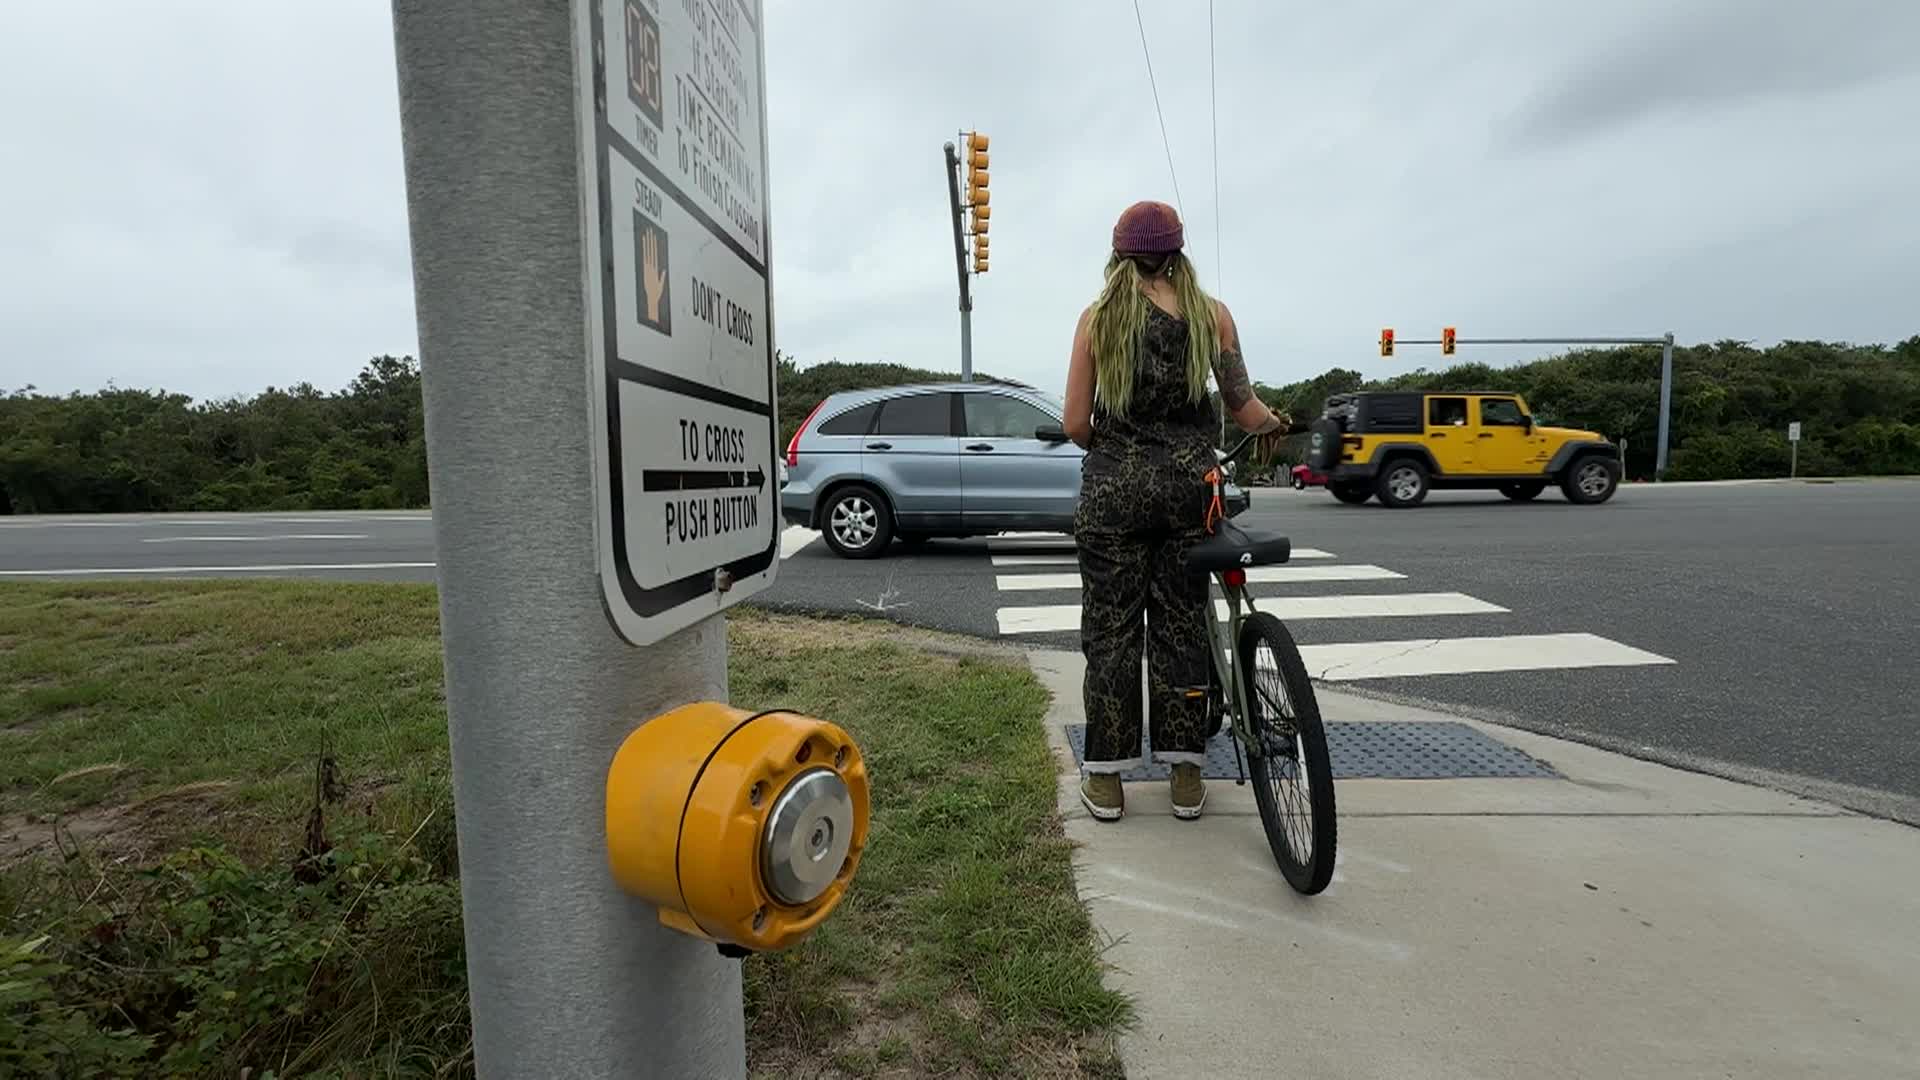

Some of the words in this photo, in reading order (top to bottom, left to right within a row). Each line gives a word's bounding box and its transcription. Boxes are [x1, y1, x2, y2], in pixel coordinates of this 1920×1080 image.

[692, 34, 701, 81] If
[704, 52, 739, 134] Started
[712, 18, 748, 116] Crossing
[634, 113, 659, 158] TIMER
[674, 74, 705, 144] TIME
[706, 114, 756, 204] REMAINING
[635, 177, 662, 221] STEADY
[675, 112, 689, 174] To
[692, 126, 724, 212] Finish
[725, 156, 760, 255] Crossing
[692, 276, 721, 329] DON'T
[726, 299, 753, 347] CROSS
[680, 419, 699, 461] TO
[705, 424, 744, 464] CROSS
[665, 500, 708, 545] PUSH
[714, 495, 758, 535] BUTTON
